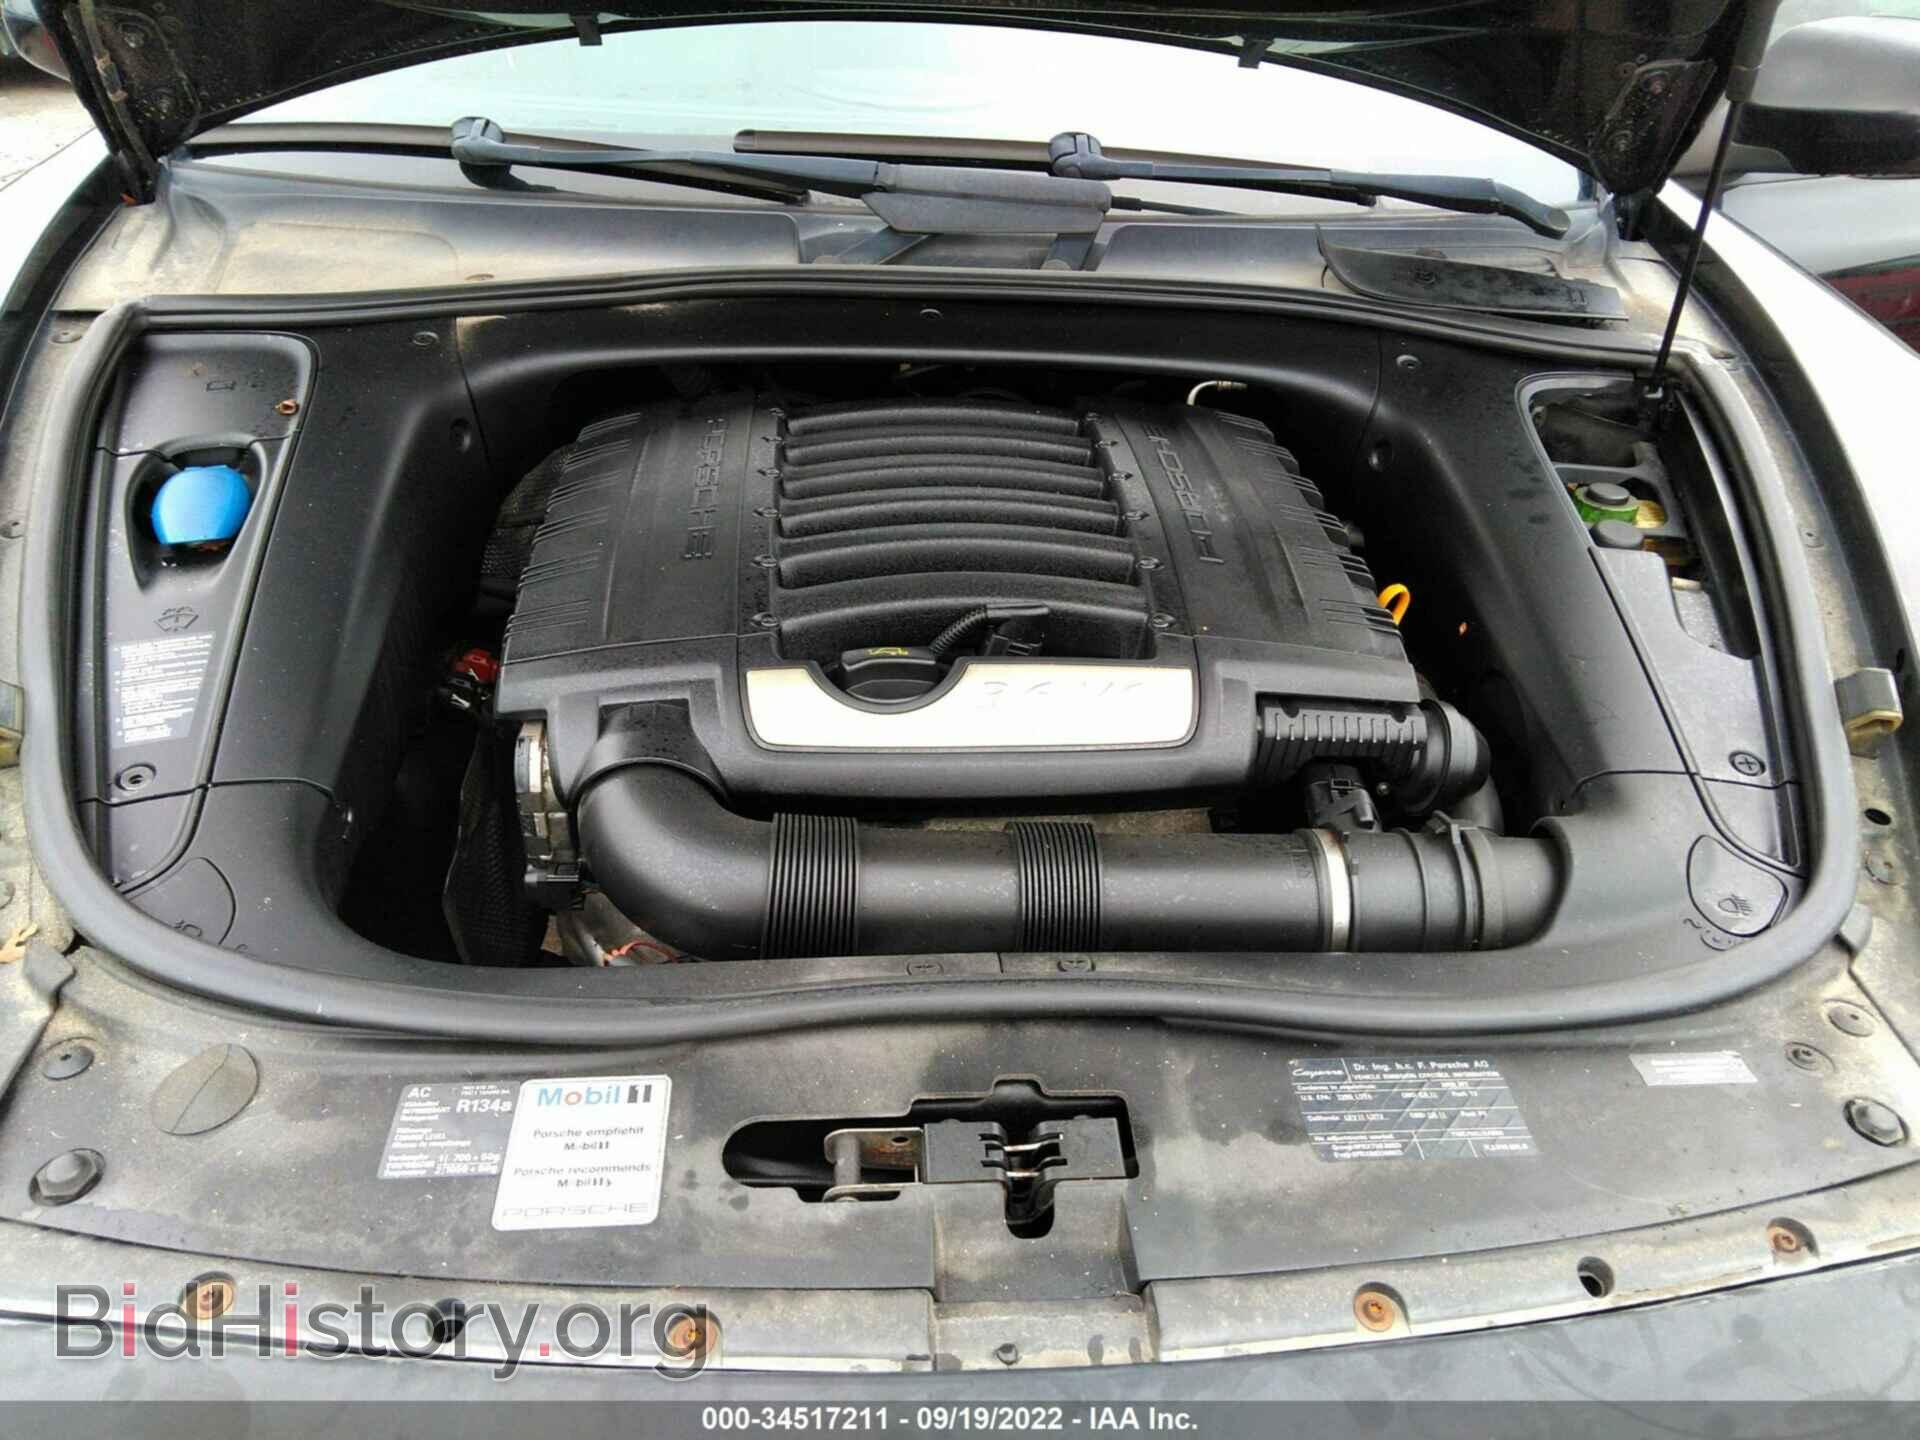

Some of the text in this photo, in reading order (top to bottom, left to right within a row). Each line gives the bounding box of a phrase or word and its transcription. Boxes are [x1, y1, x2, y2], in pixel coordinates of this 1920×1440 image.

[1430, 1060, 1470, 1070] Porsche
[1473, 1059, 1489, 1069] AG
[1292, 1068, 1345, 1079] Cayenne
[407, 1087, 432, 1098] AC
[537, 1084, 621, 1107] Mobil
[456, 1098, 513, 1113] R134a
[533, 1128, 582, 1139] Porsche
[514, 1163, 651, 1176] Porsche recommends
[502, 1202, 649, 1217] PORSCHE
